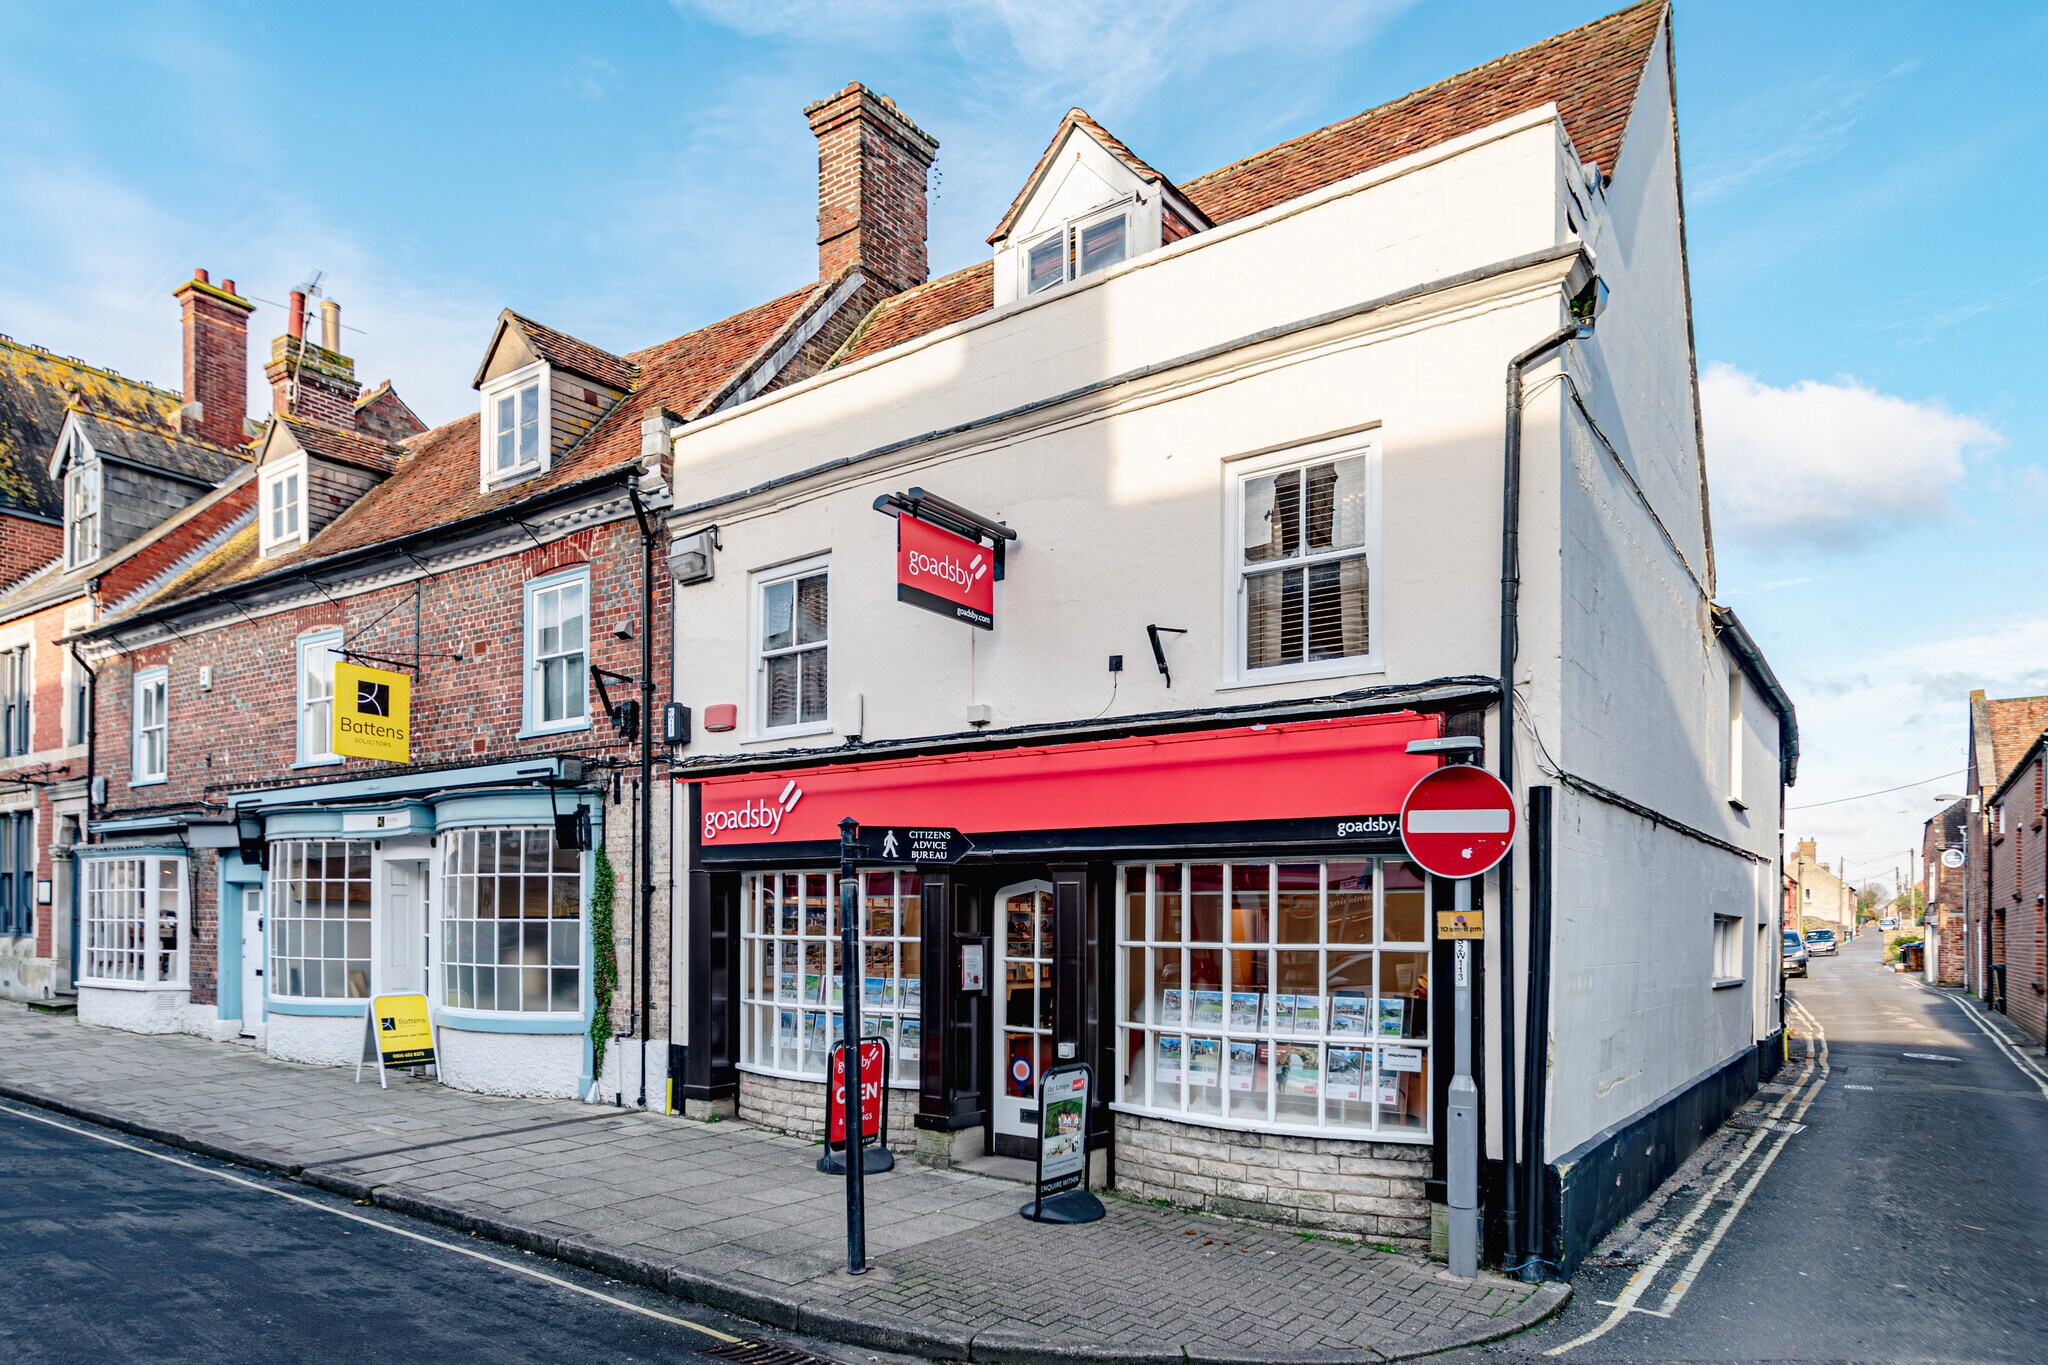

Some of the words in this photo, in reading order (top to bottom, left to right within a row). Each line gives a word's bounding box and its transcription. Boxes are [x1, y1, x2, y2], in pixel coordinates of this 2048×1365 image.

[908, 550, 974, 593] goadsby
[956, 607, 991, 624] goadsby.com
[341, 717, 404, 740] Battens
[354, 737, 392, 748] SOLICITORS
[704, 799, 784, 838] goadsby
[1337, 816, 1400, 836] goadsby.
[908, 830, 951, 840] CITIZENS
[912, 841, 947, 850] ADVICE
[911, 850, 948, 860] BUREAU
[398, 1017, 426, 1025] Battens
[836, 1081, 878, 1104] OEN
[1040, 1180, 1063, 1193] ENQUIRE
[1062, 1175, 1080, 1187] WITHIN
